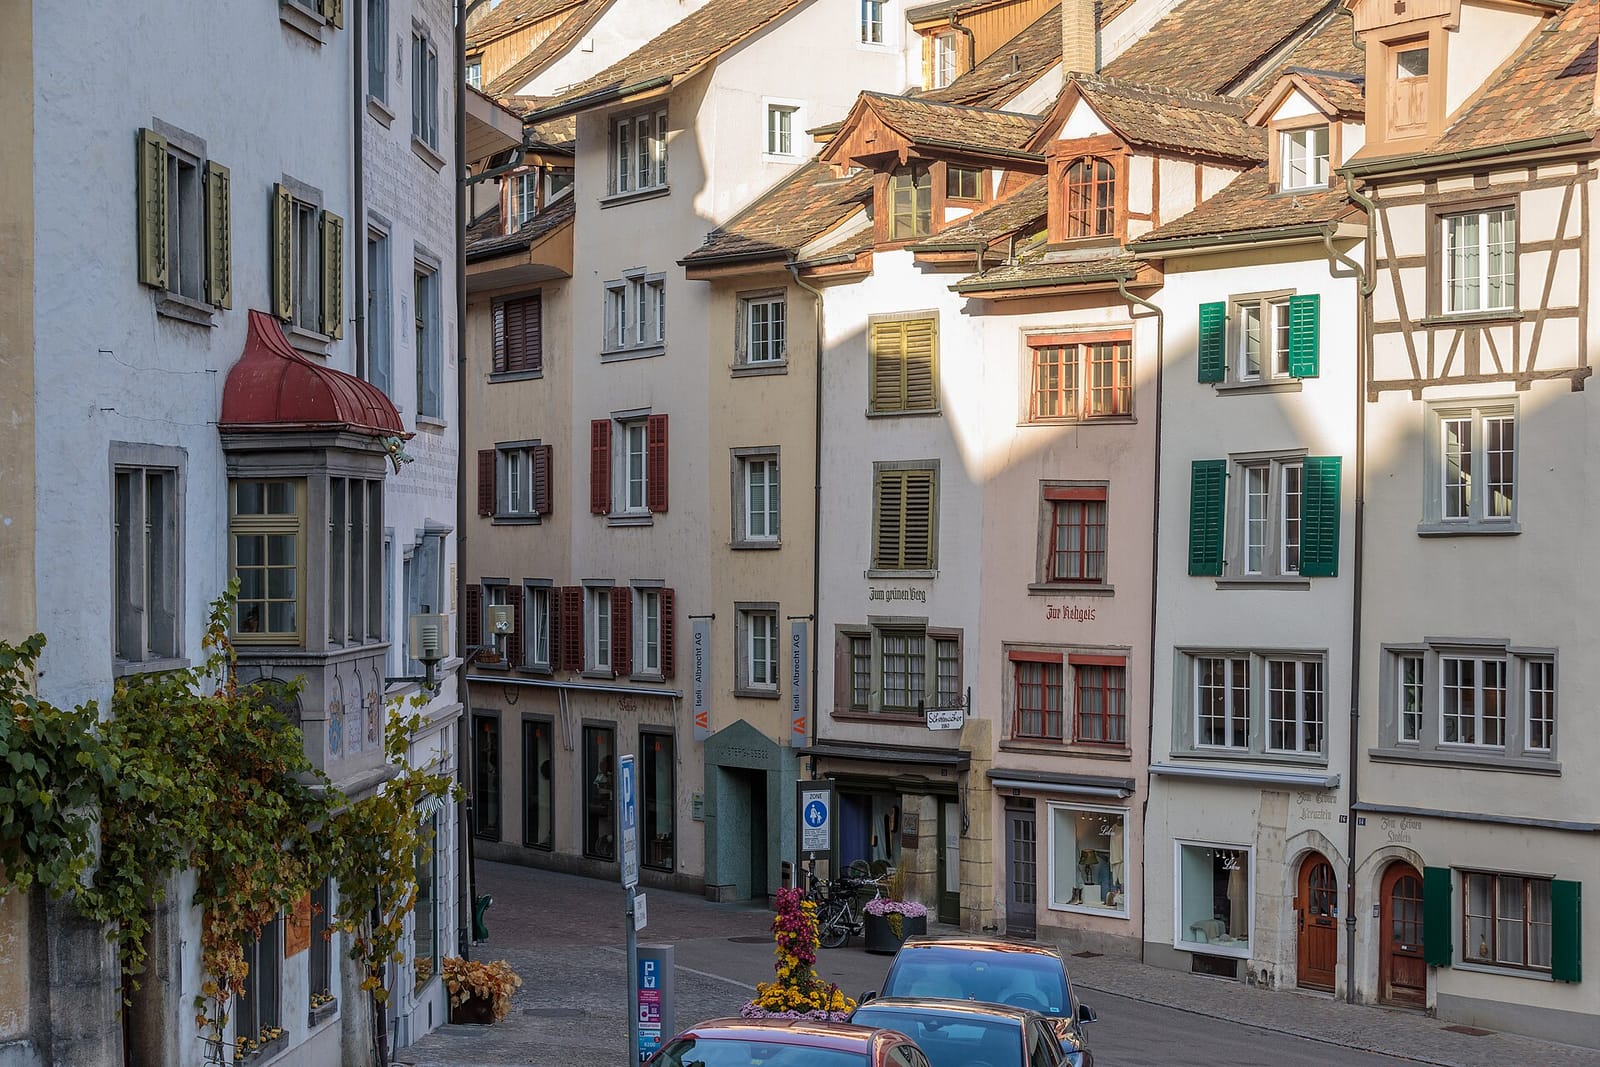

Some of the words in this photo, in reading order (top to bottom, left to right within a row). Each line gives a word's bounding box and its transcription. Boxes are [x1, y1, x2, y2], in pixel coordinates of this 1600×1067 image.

[1046, 604, 1061, 620] Zur
[695, 632, 702, 646] AG
[793, 634, 800, 648] AG
[623, 767, 631, 822] P
[644, 961, 655, 976] P
